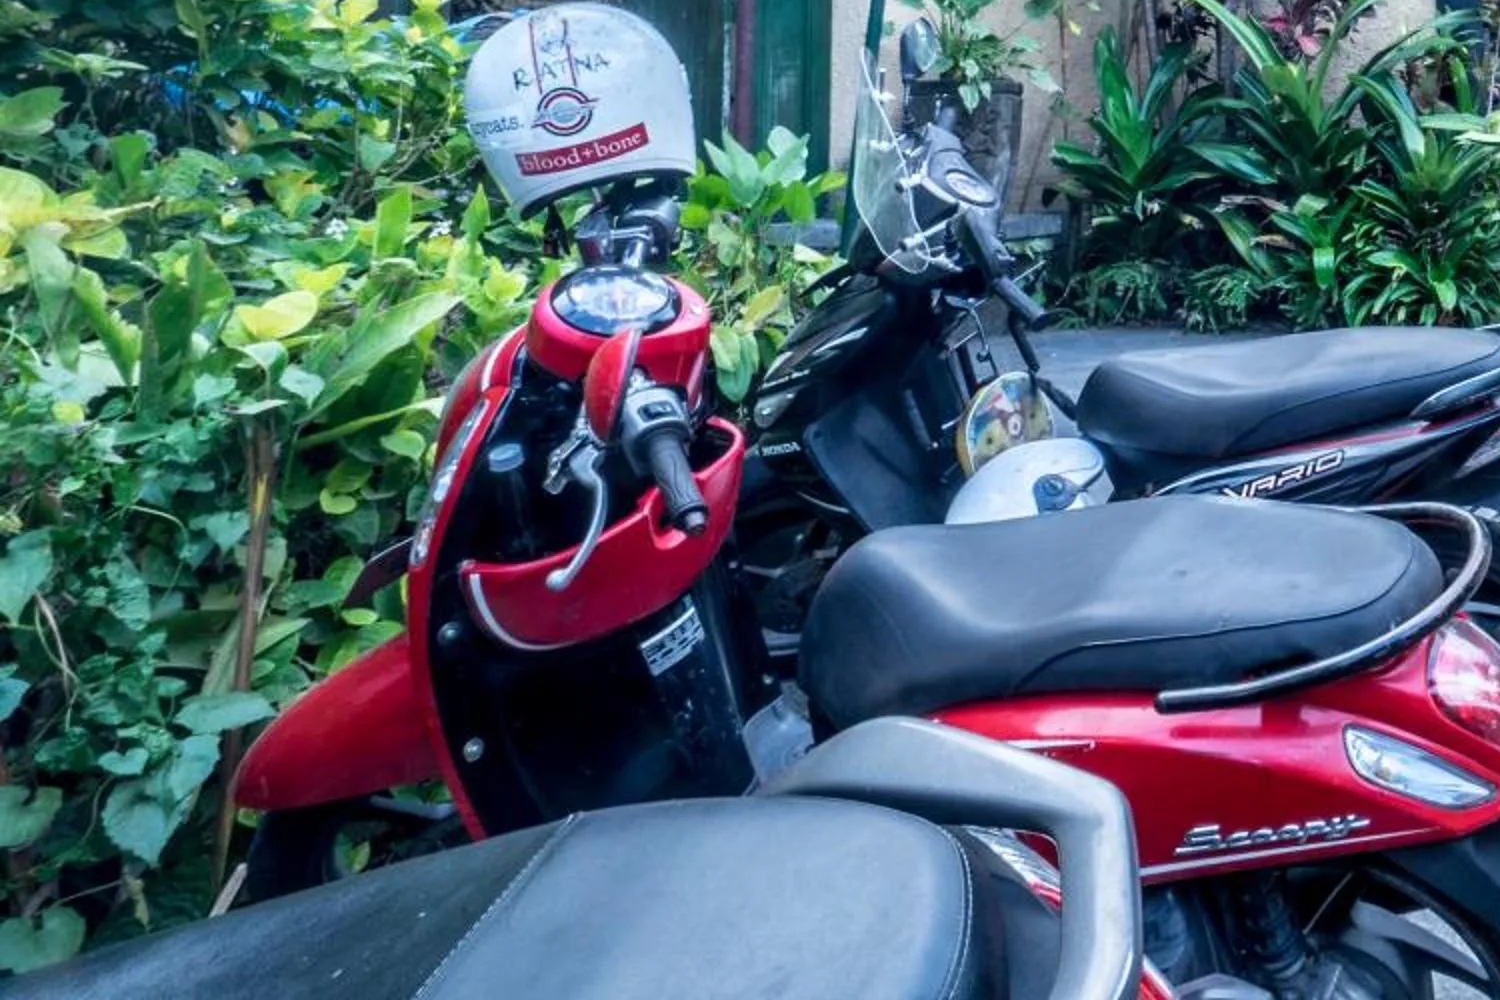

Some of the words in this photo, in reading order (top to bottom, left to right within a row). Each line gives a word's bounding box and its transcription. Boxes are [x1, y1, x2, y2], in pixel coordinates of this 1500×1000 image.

[513, 53, 609, 91] RATNA
[520, 130, 642, 172] blood+bone
[761, 442, 801, 457] HONDA
[1223, 450, 1344, 498] VARIO
[1174, 814, 1371, 855] Scoopy
